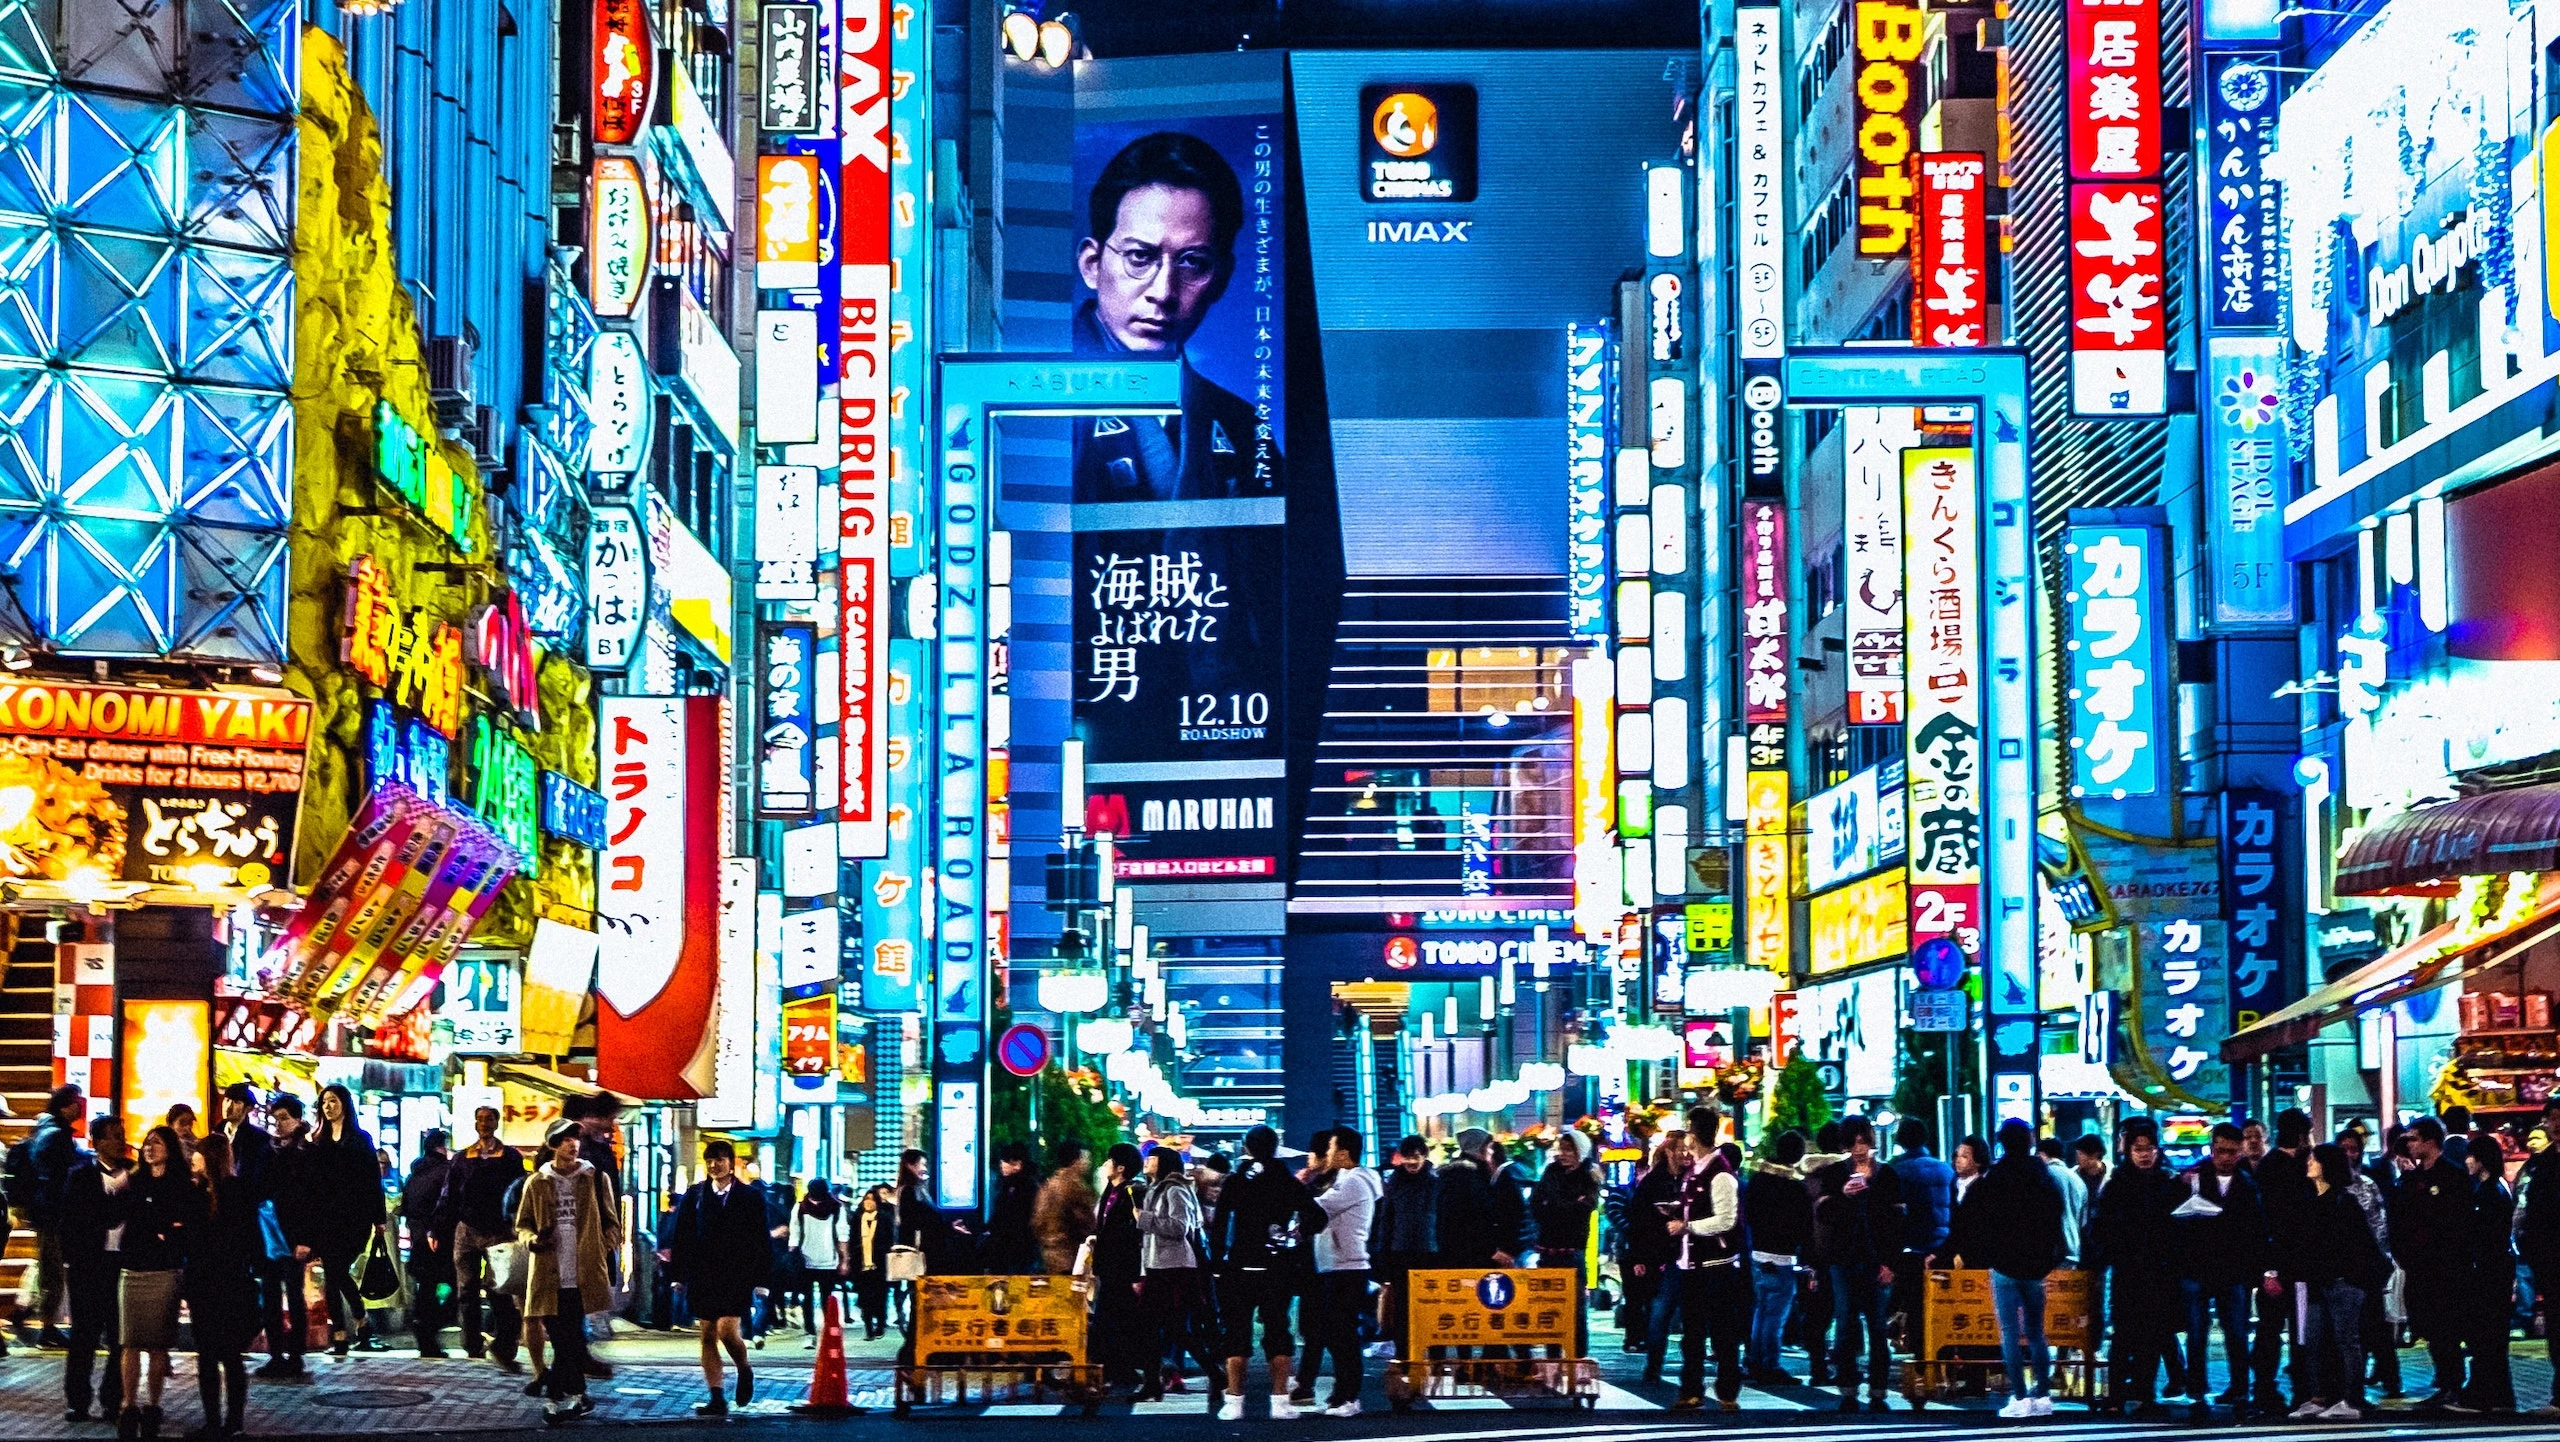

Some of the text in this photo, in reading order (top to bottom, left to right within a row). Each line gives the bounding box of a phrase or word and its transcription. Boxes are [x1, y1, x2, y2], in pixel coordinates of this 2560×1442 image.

[1751, 22, 1768, 132] ネットカフェ
[2088, 20, 2141, 174] 居楽屋
[1752, 144, 1767, 160] &
[1857, 1, 1922, 254] Booth
[1367, 221, 1470, 242] IMAX
[2368, 263, 2409, 328] Don
[841, 298, 876, 538] BIC DRUG
[1744, 374, 1782, 476] Booth
[597, 473, 626, 490] 1F
[2231, 439, 2253, 530] STAGE
[2253, 440, 2275, 510] IDOL
[1089, 551, 1230, 609] 海賊と
[2232, 562, 2275, 590] 5F
[599, 638, 626, 656] B1
[1091, 610, 1218, 645] よばれた
[1088, 648, 1141, 703] 男
[2082, 535, 2148, 785] カラオケ
[197, 698, 310, 744] YAKI
[945, 462, 977, 963] GODZILLA ROAD
[1179, 692, 1269, 726] 12.10
[1181, 727, 1267, 741] ROADSHOW
[1751, 723, 1785, 745] 4F
[85, 761, 144, 785] Drinks
[145, 765, 172, 786] for
[173, 768, 188, 787] 2
[189, 768, 243, 789] hours
[88, 742, 149, 763] dinner
[149, 745, 189, 765] with
[190, 745, 303, 773] Free-Flowing
[1751, 746, 1785, 766] 3F
[610, 715, 649, 893] トラノコ
[1141, 797, 1274, 832] MARUHAN
[1915, 712, 1980, 875] 金の蔵
[1914, 890, 1967, 932] 2F
[2233, 801, 2279, 999] カラオケ
[2161, 918, 2209, 1082] カラオケ
